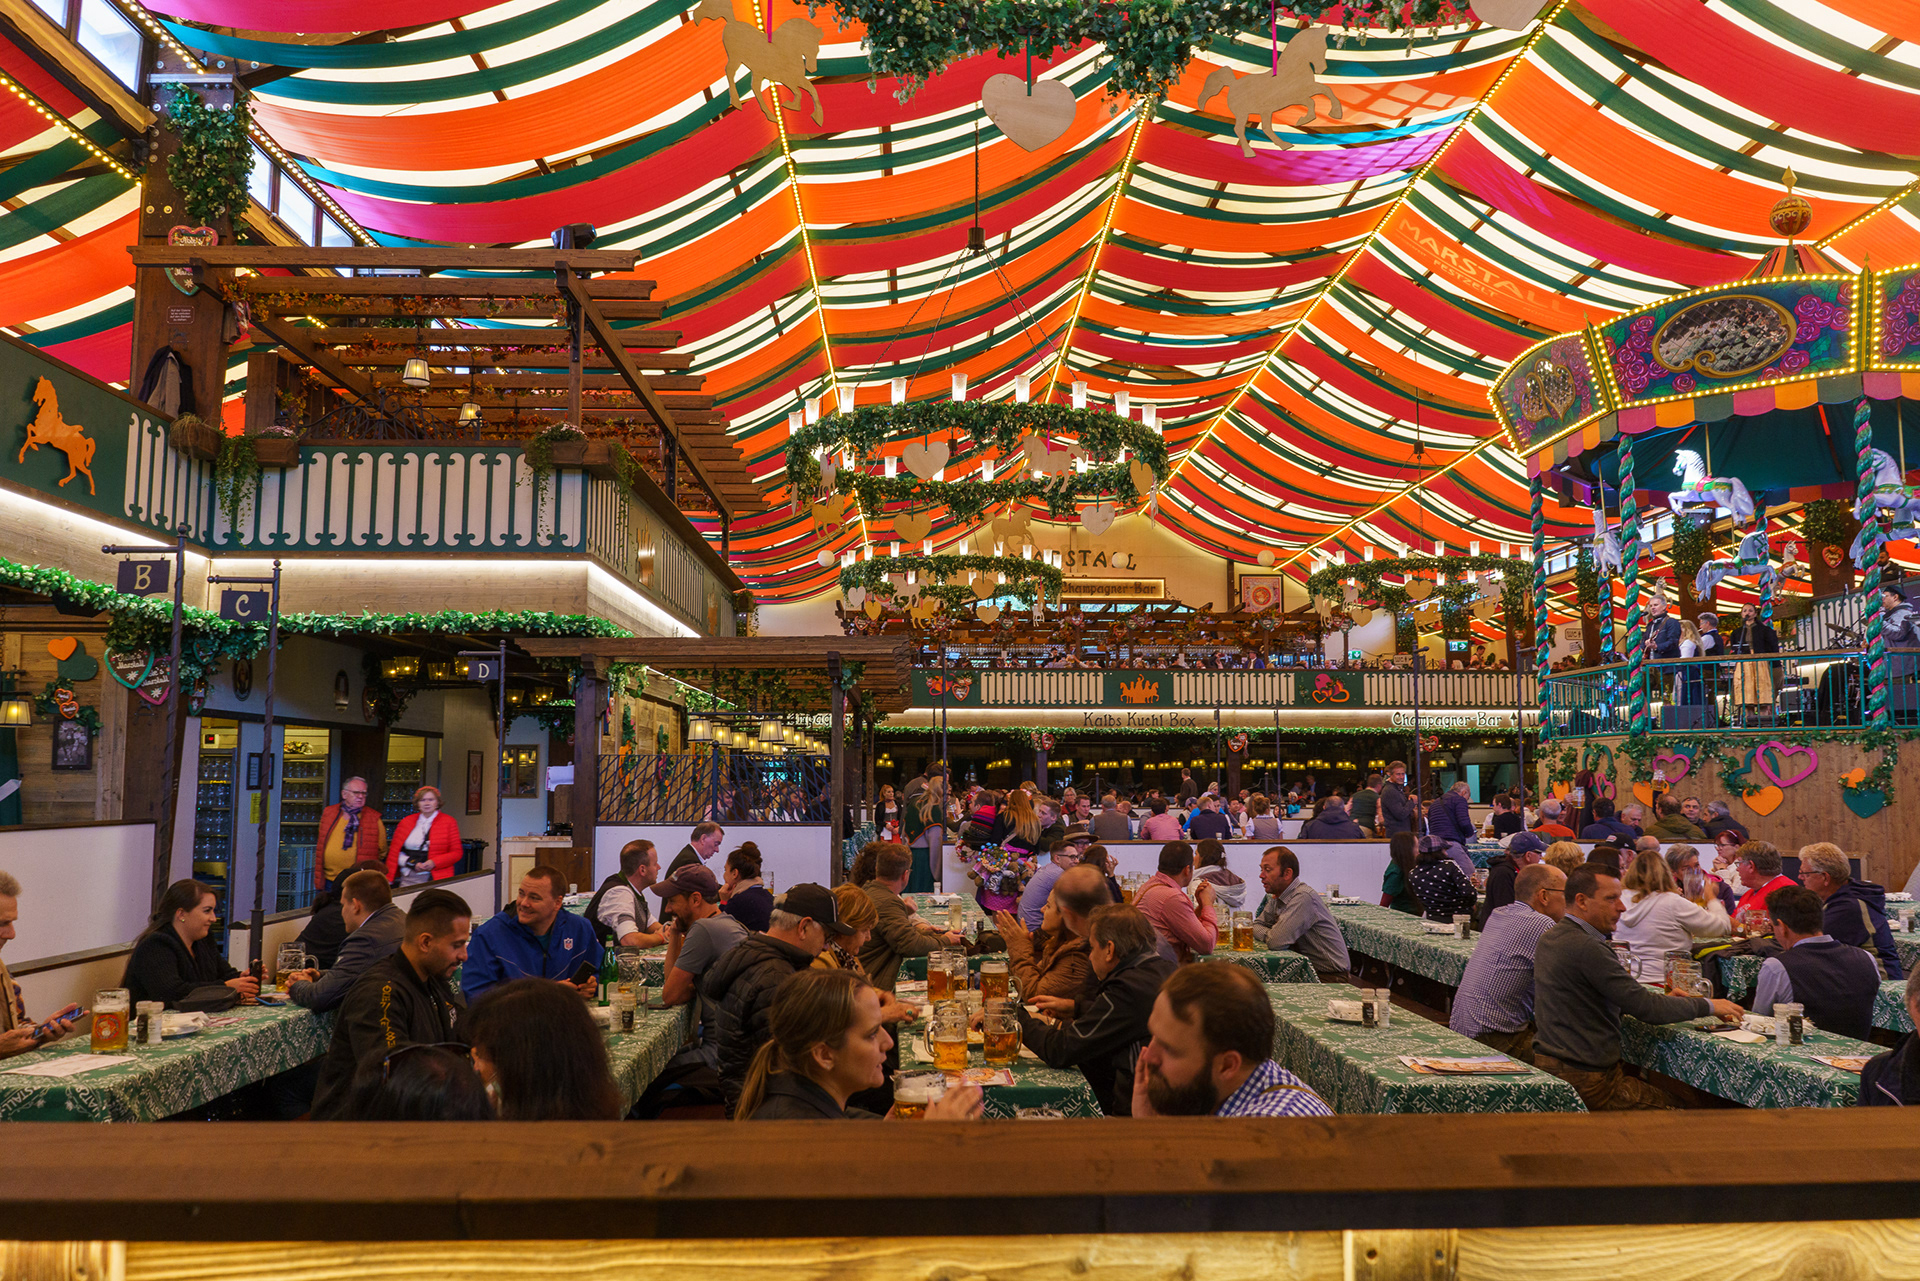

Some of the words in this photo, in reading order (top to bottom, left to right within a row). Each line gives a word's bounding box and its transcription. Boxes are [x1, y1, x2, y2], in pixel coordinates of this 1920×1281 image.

[1399, 218, 1576, 317] MARSTALL
[1433, 259, 1498, 298] FESTZELT
[134, 565, 152, 590] B
[1061, 582, 1157, 596] Champagner-Bar
[235, 594, 251, 617] C
[478, 663, 490, 678] D
[1083, 712, 1122, 727] Kalbs
[1127, 712, 1163, 727] Kuchl
[1169, 712, 1197, 727] Box
[1391, 711, 1503, 729] Champagner-Bar
